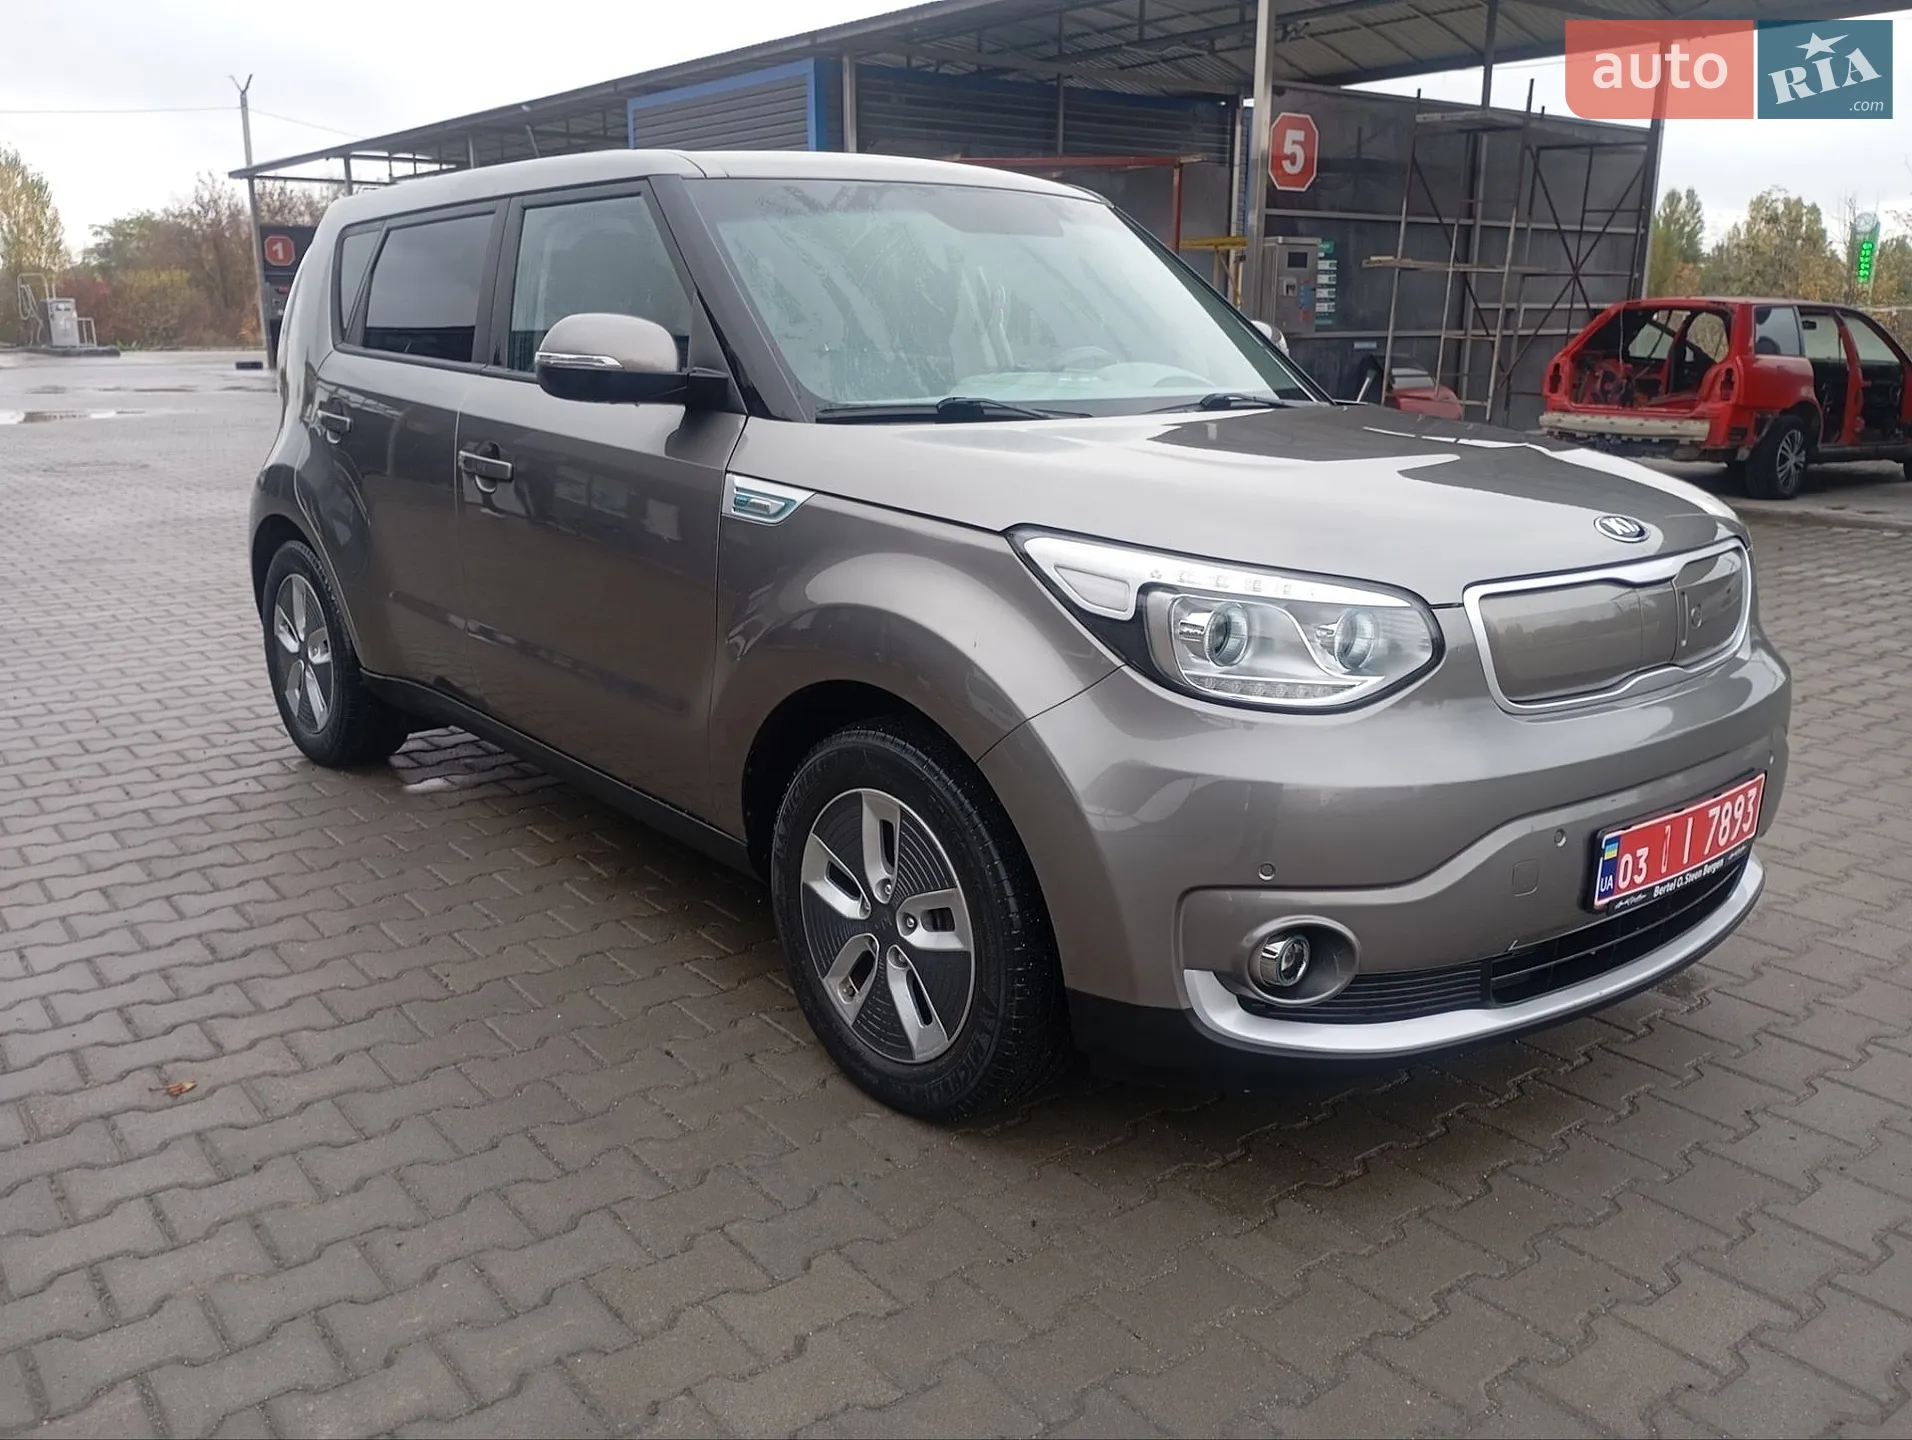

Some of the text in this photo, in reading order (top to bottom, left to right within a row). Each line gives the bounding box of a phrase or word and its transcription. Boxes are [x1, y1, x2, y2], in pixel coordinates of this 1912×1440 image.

[1281, 129, 1305, 175] 5
[272, 242, 285, 260] 1
[1617, 846, 1649, 890] 03
[1703, 787, 1758, 856] 7893
[1600, 876, 1613, 893] UA
[1653, 877, 1677, 898] Bertel
